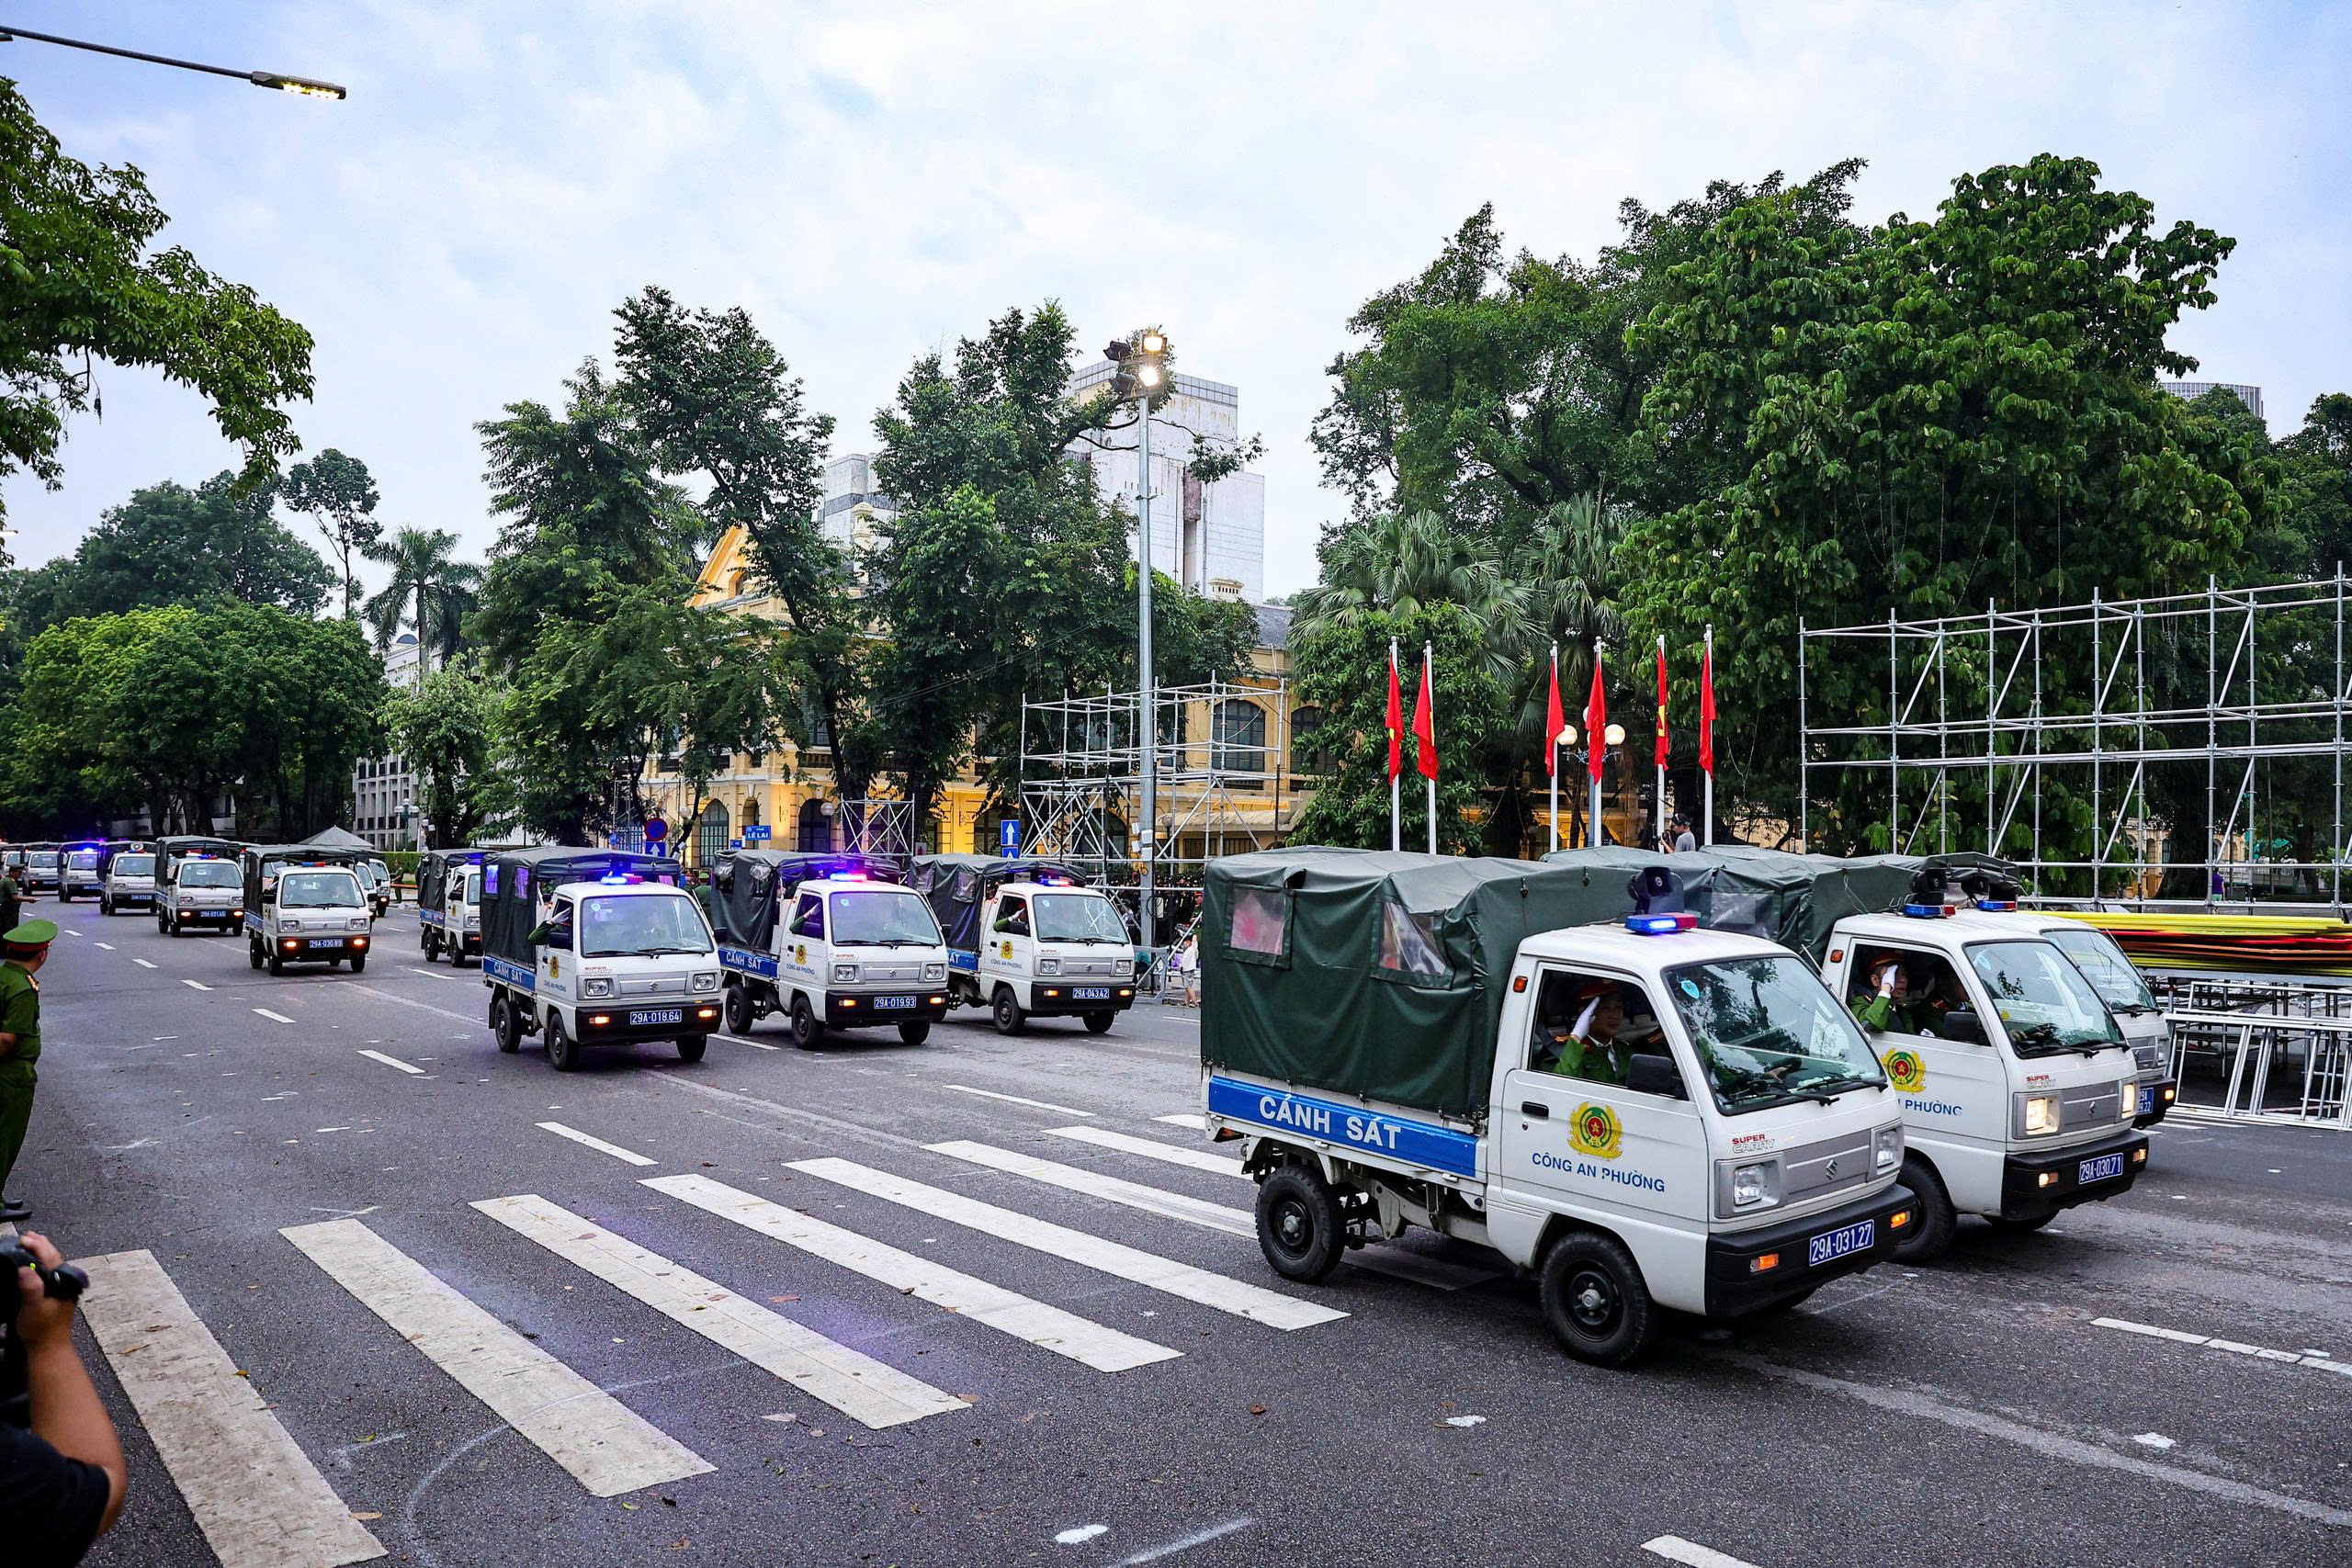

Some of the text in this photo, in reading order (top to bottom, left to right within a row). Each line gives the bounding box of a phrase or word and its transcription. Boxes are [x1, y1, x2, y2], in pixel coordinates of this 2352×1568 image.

[948, 950, 960, 964] ÁT
[1074, 989, 1108, 998] 29A-043.42
[875, 998, 915, 1008] 29A-019.93
[631, 1011, 680, 1023] 29A-018.64
[1260, 1094, 1401, 1149] CẢNH SÁT
[1732, 1134, 1765, 1145] SUPER
[1733, 1139, 1775, 1154] CARRY
[1532, 1152, 1665, 1192] CÔNG AN PHƯỜNG
[2081, 1156, 2120, 1181] 29A-030.71
[1812, 1224, 1871, 1262] 29A-031.27
